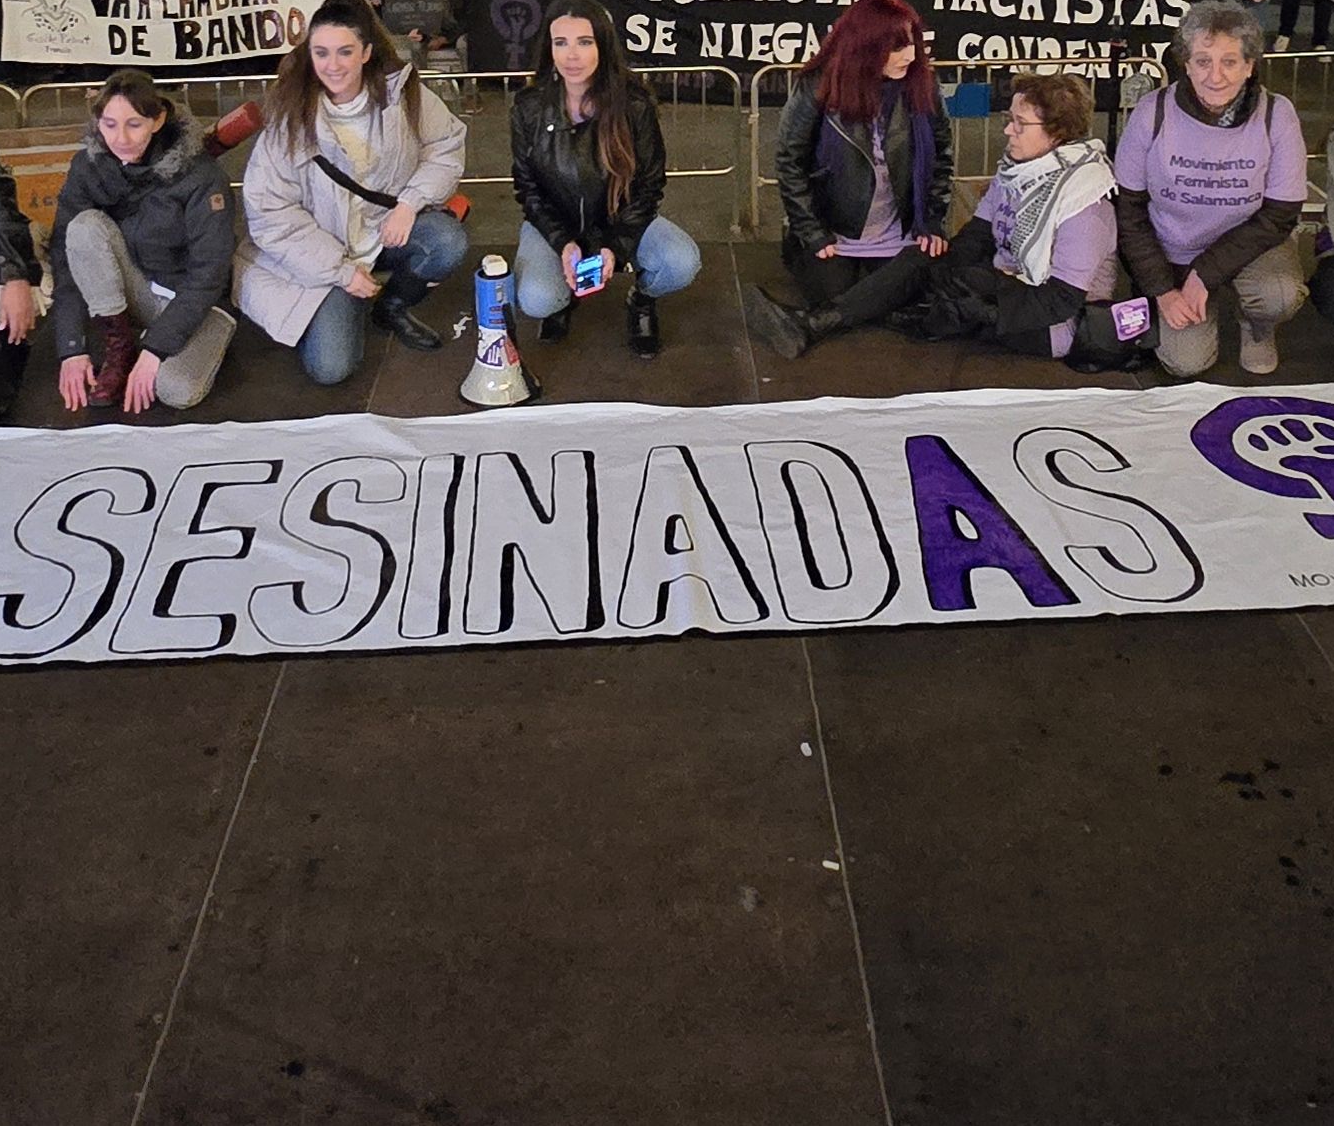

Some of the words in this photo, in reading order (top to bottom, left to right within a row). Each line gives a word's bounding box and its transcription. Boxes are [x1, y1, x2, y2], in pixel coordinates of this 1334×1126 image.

[108, 24, 152, 57] DE
[172, 6, 307, 60] BANDO
[625, 14, 677, 56] SE
[1169, 154, 1256, 171] Movimiento
[1174, 174, 1249, 189] Feminista
[1160, 187, 1177, 201] de
[1179, 191, 1262, 207] Salamanca
